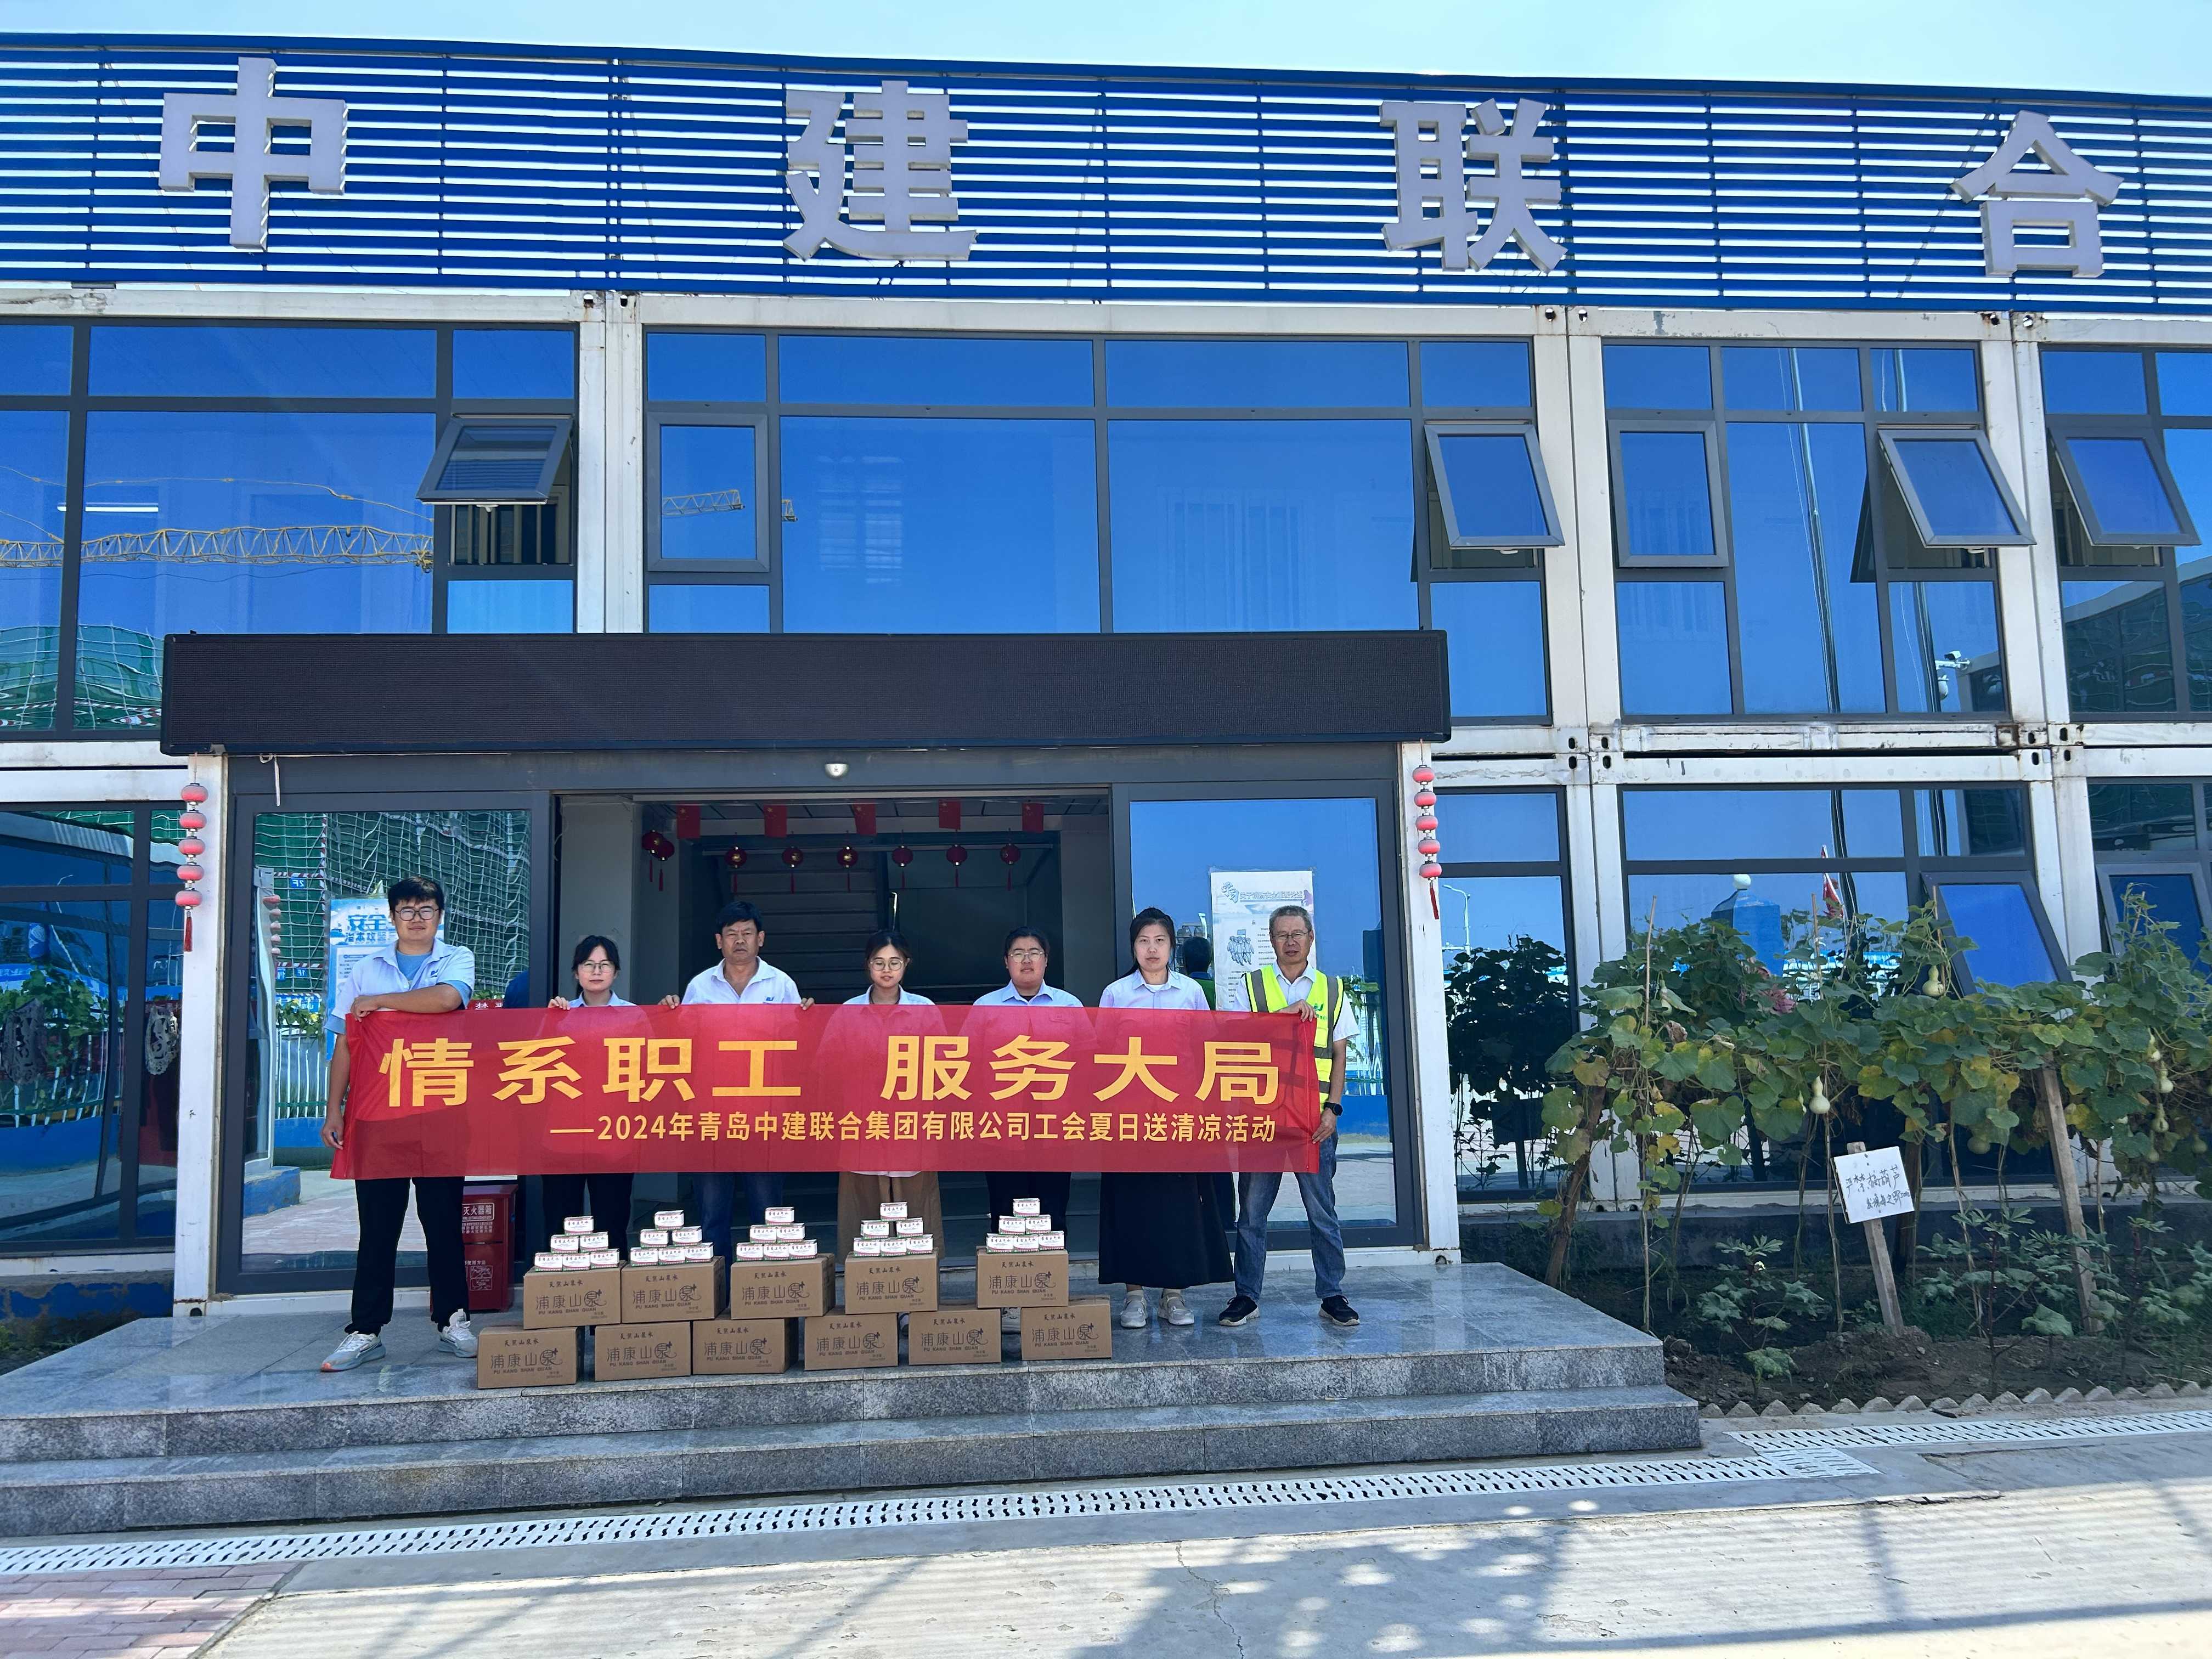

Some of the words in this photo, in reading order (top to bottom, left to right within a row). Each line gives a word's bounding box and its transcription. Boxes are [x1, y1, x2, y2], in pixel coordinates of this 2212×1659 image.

[348, 915, 395, 931] 安全
[379, 1036, 801, 1107] 情系职工
[881, 1035, 1280, 1104] 服务大局
[463, 1205, 492, 1216] 灭火器箱
[549, 1279, 583, 1288] 天然山泉水
[645, 1274, 679, 1282] 天然山泉水
[856, 1277, 920, 1295] 浦康山泉
[989, 1271, 1052, 1289] 浦康山泉
[536, 1290, 602, 1310] 浦康山泉
[633, 1285, 698, 1305] 浦康山泉
[742, 1282, 806, 1300] 浦康山泉
[830, 1322, 862, 1330] 天然山泉水
[1031, 1323, 1095, 1342] 浦康山泉
[504, 1339, 539, 1347] 天然山泉水
[816, 1332, 881, 1352] 浦康山泉
[921, 1328, 985, 1347] 浦康山泉
[607, 1342, 673, 1362] 浦康山泉
[704, 1338, 768, 1356] 浦康山泉
[491, 1348, 558, 1369] 浦康山泉
